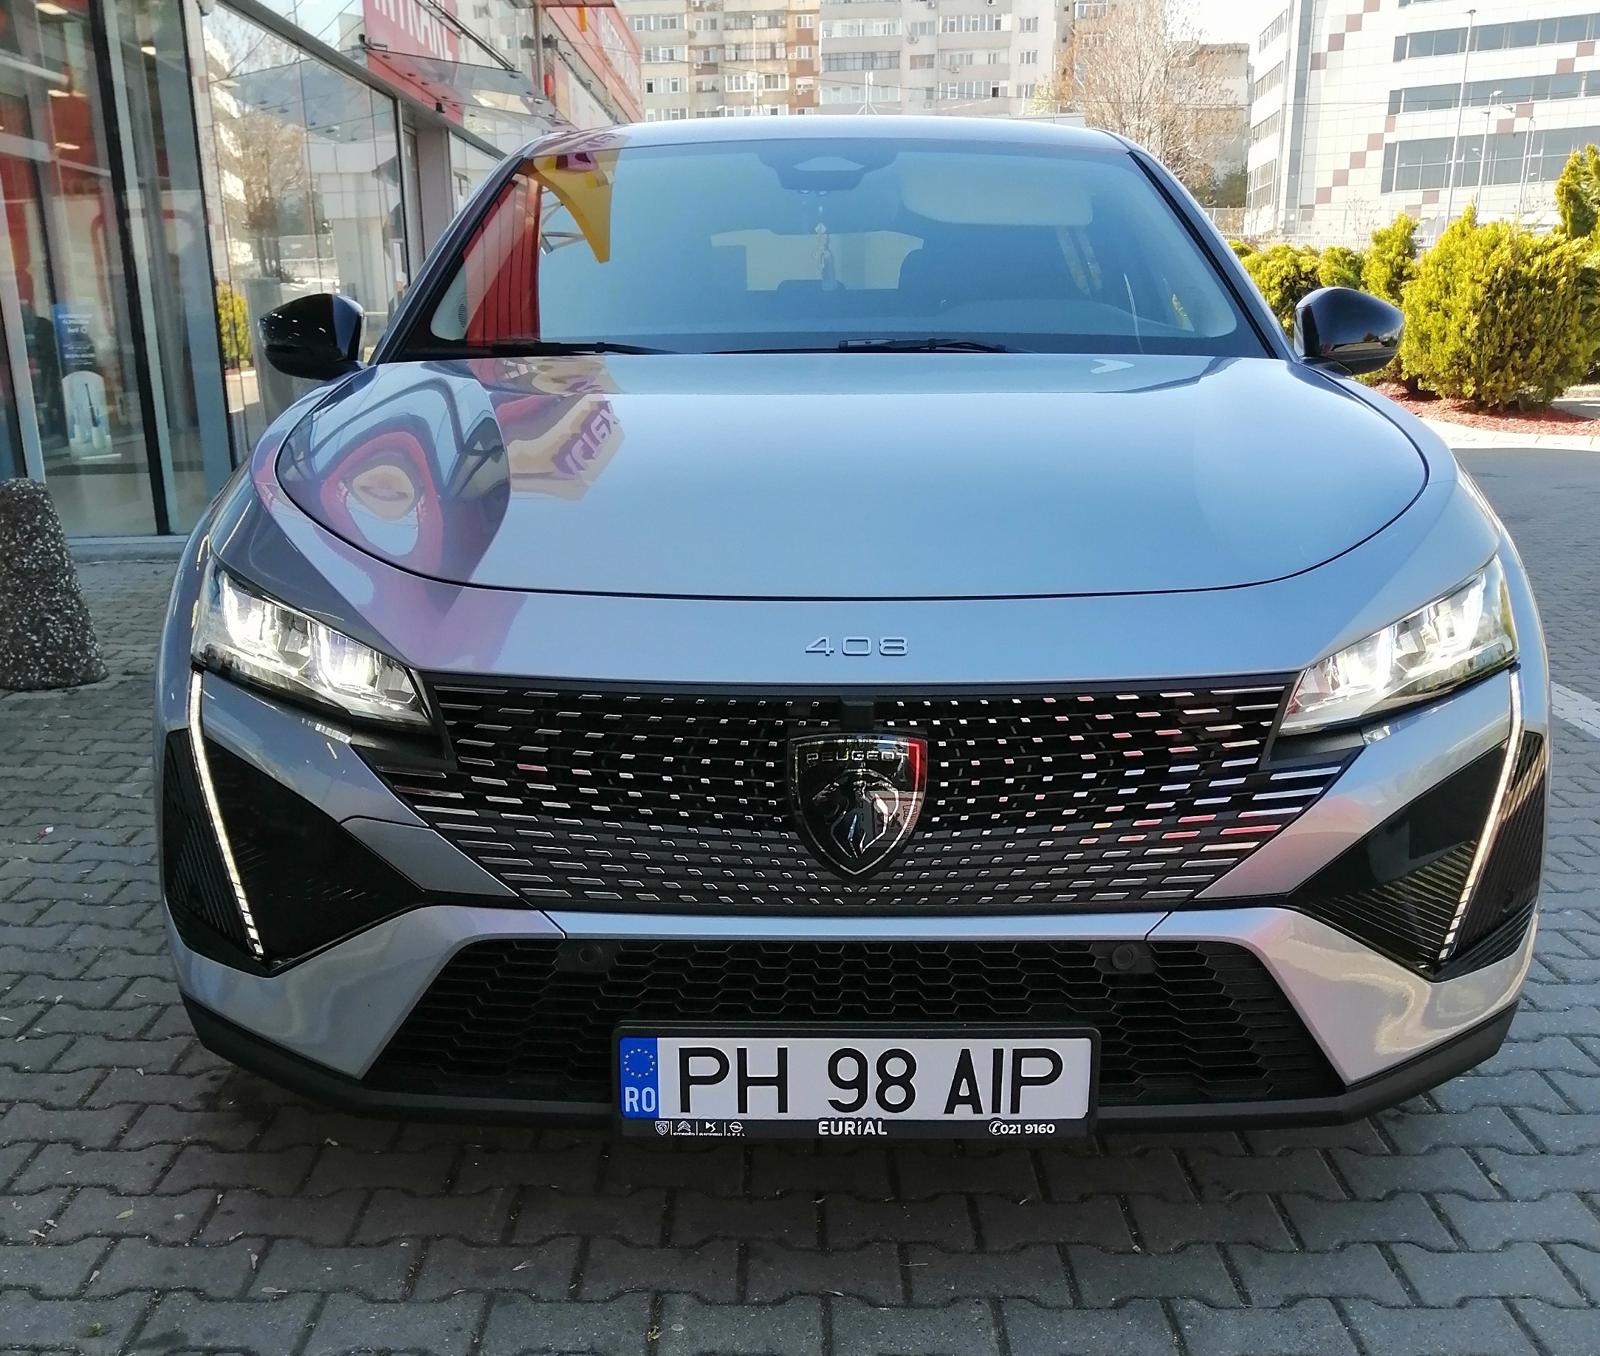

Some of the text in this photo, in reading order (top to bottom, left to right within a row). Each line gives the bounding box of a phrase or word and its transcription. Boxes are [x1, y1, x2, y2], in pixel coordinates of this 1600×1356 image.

[805, 636, 909, 656] 408
[806, 750, 909, 763] PEUGEOT
[679, 1047, 1064, 1114] PH 98 AIP
[624, 1086, 656, 1113] RO
[1000, 1123, 1056, 1135] 021 9160
